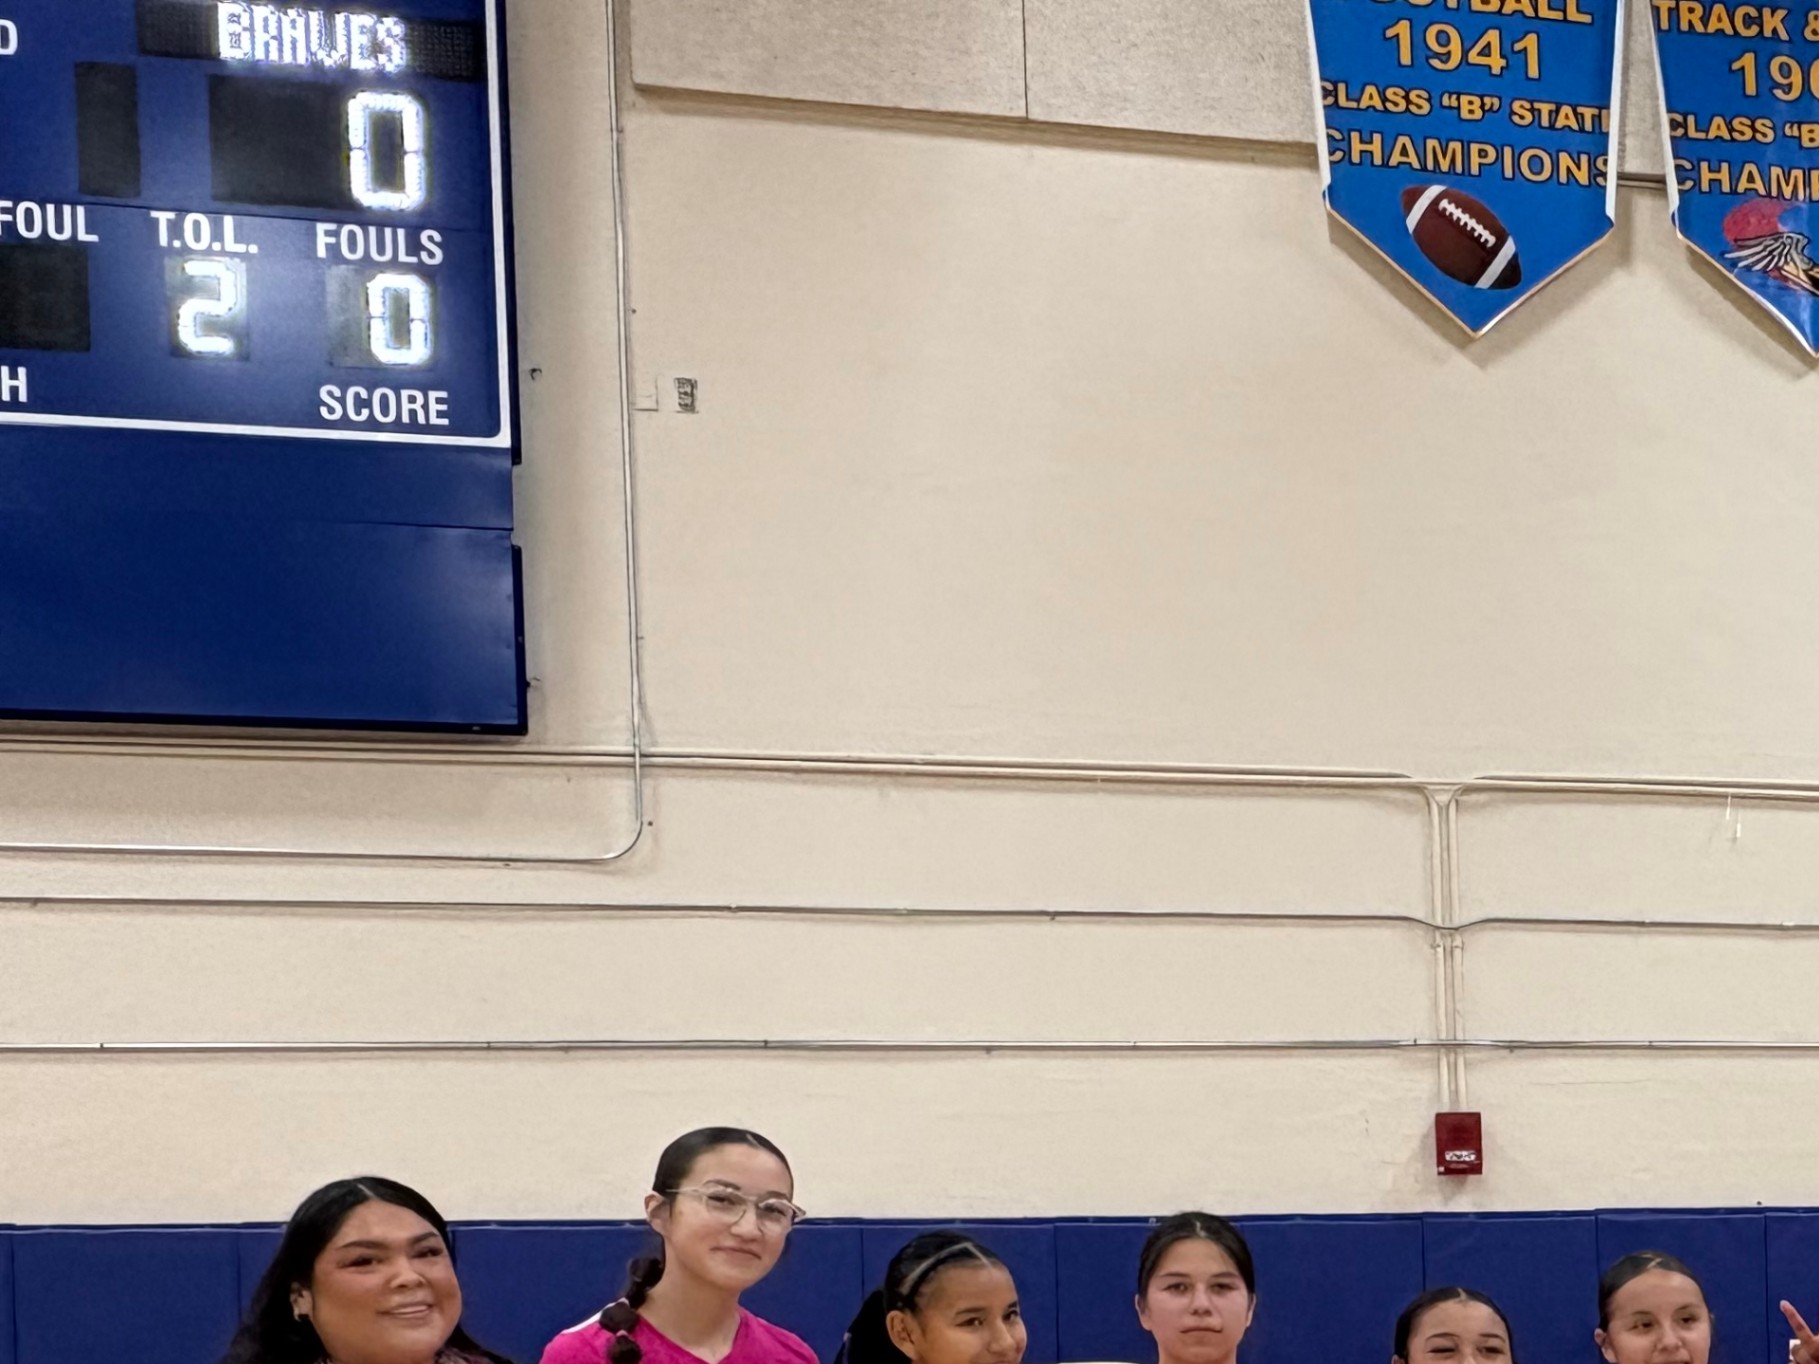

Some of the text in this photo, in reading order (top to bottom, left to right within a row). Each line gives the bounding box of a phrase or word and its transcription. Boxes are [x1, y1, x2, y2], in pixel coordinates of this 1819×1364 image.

[1655, 1, 1789, 41] TRACK
[1384, 19, 1540, 79] 1941
[1668, 113, 1774, 144] CLASS
[347, 91, 426, 211] 0
[150, 211, 259, 255] T.O.L.
[317, 223, 444, 265] FOULS
[177, 258, 240, 357] 2
[366, 273, 432, 366] 0
[320, 385, 449, 426] SCORE
